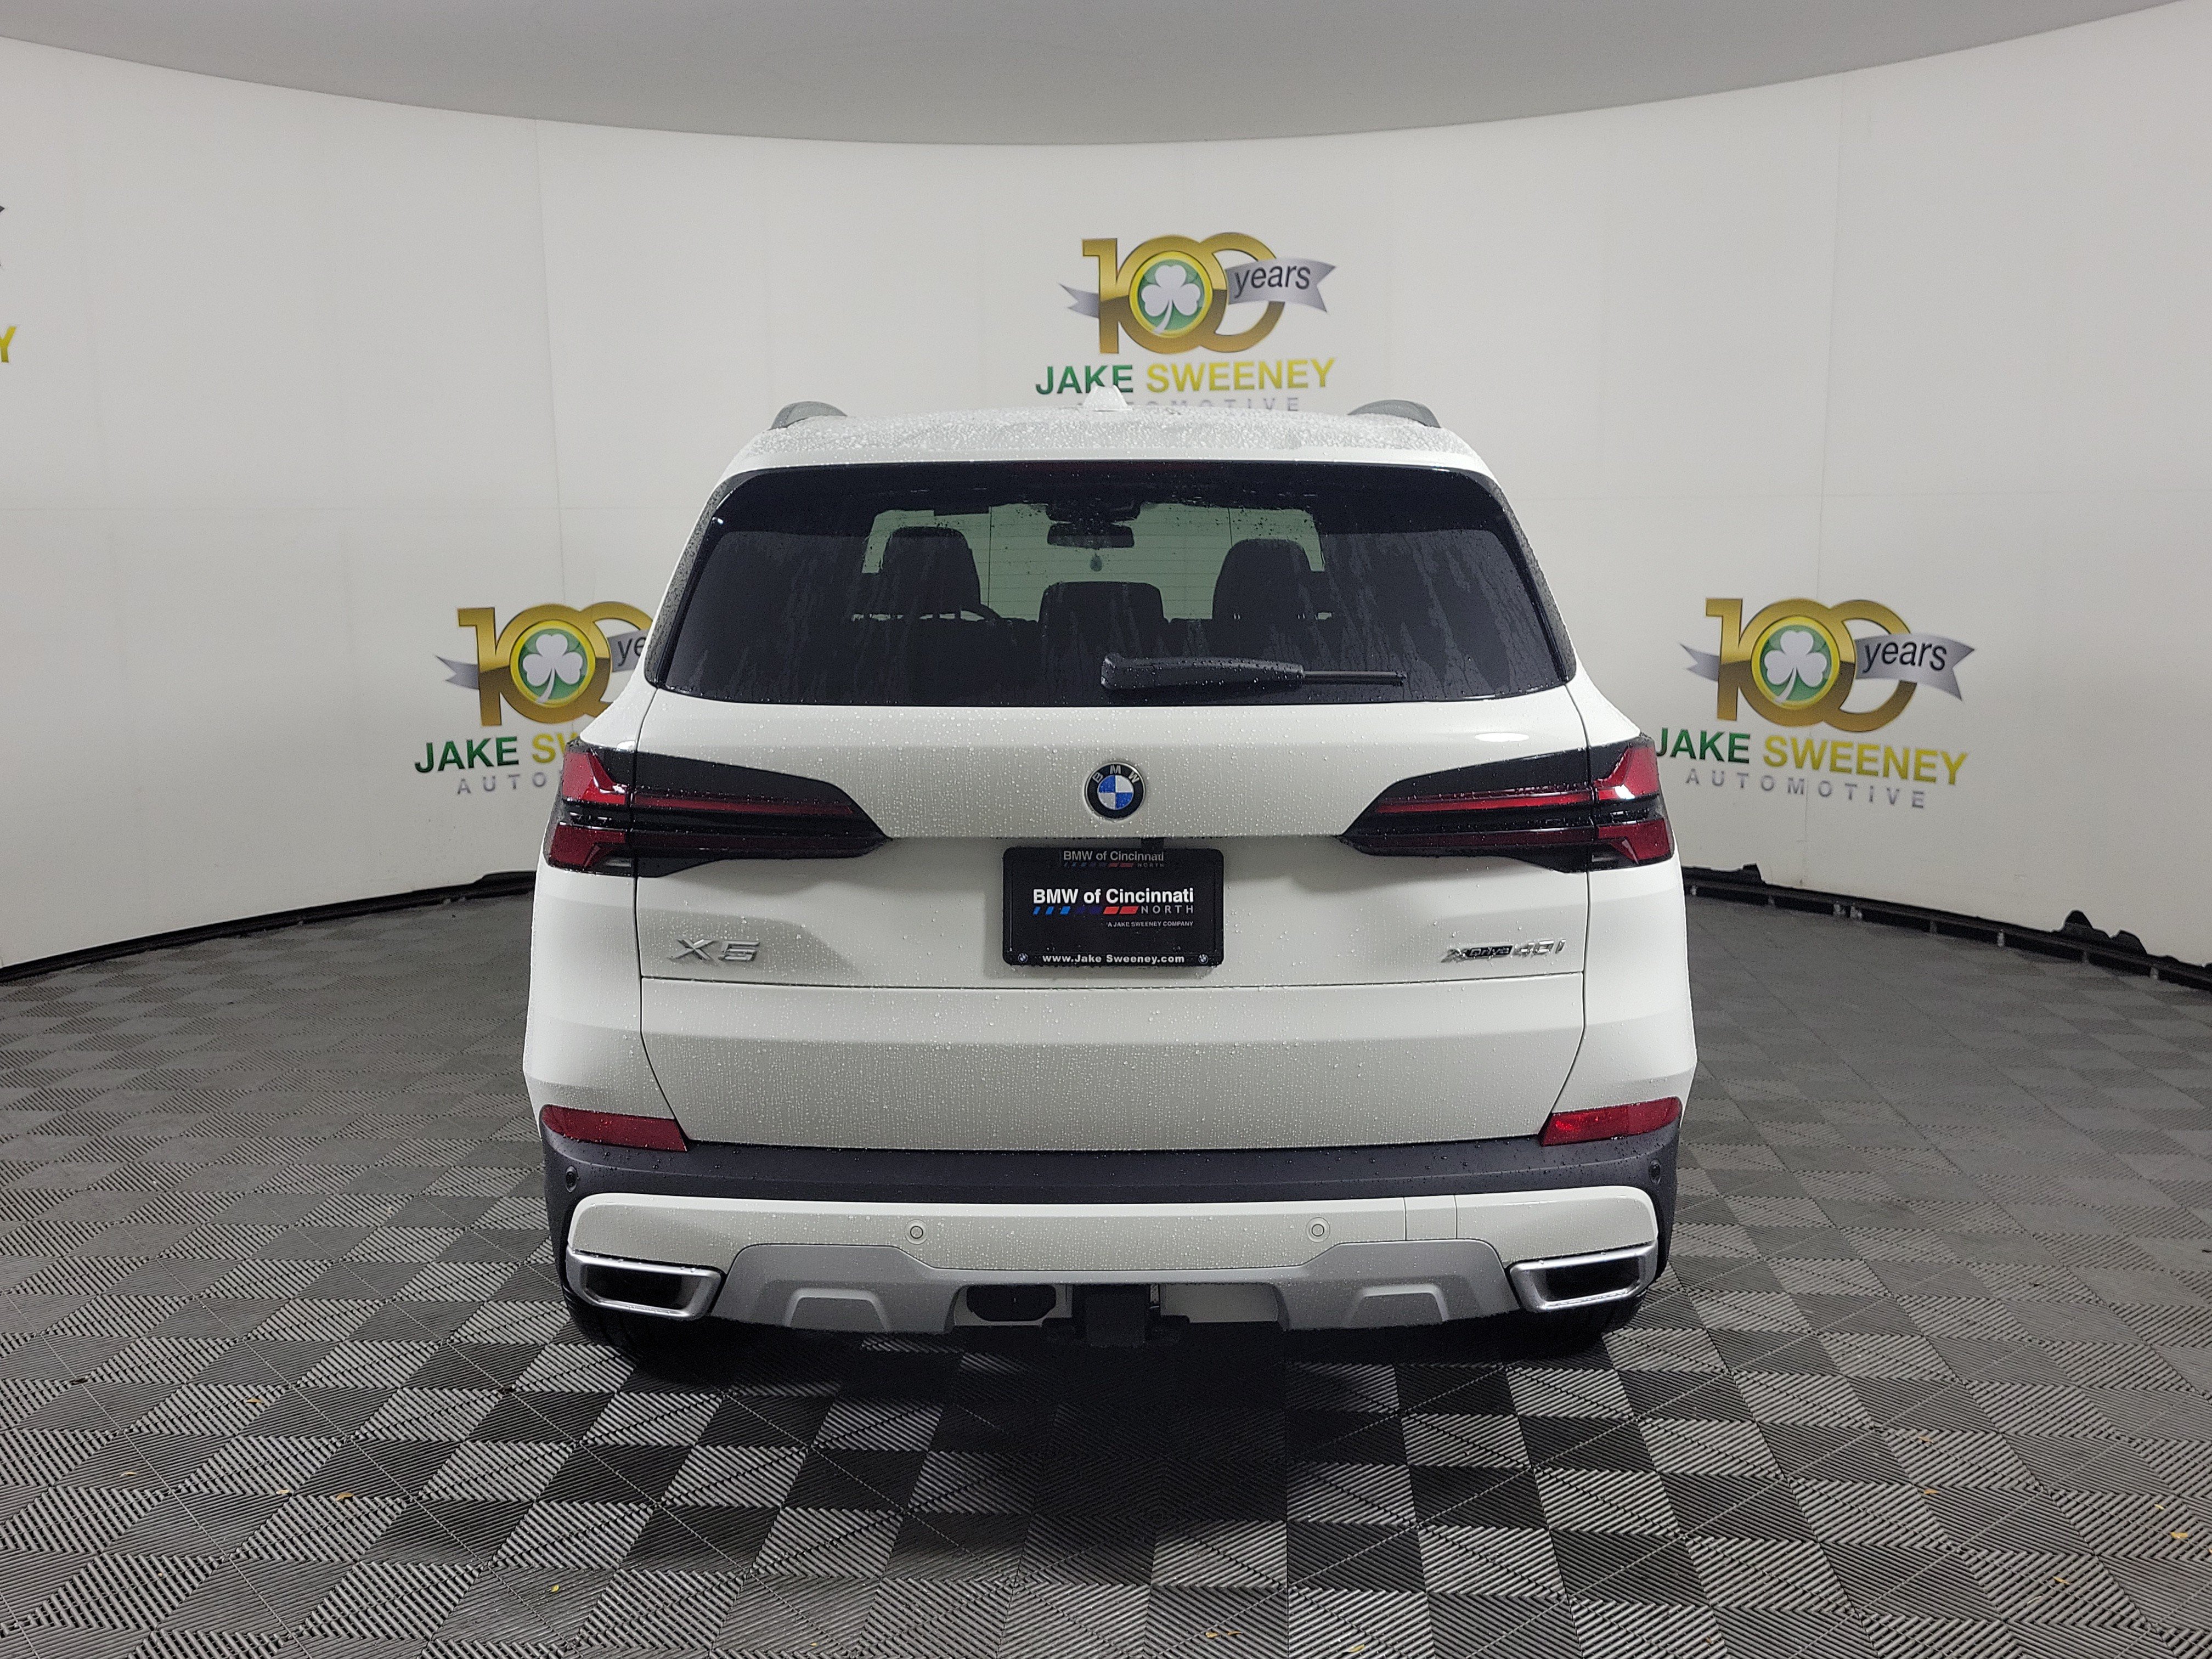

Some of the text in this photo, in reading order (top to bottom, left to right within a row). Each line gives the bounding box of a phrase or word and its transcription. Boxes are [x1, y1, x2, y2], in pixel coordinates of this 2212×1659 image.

[1081, 232, 1285, 354] 100
[1234, 264, 1311, 298] years
[1036, 357, 1336, 394] JAKE SWEENEY
[1706, 598, 1917, 732] 100
[1862, 641, 1947, 673] years
[414, 736, 519, 774] JAKE
[1656, 727, 1969, 785] JAKE SWEENEY
[1092, 764, 1139, 783] BMW
[1685, 768, 1926, 809] AUTOMOTIVE
[1063, 850, 1093, 860] BMW
[1096, 850, 1107, 860] of
[1033, 888, 1194, 904] BMW of Cincinnati
[1141, 905, 1193, 914] NORTH
[667, 939, 760, 962] X5
[1042, 954, 1184, 964] www.Jake Sweeney.com
